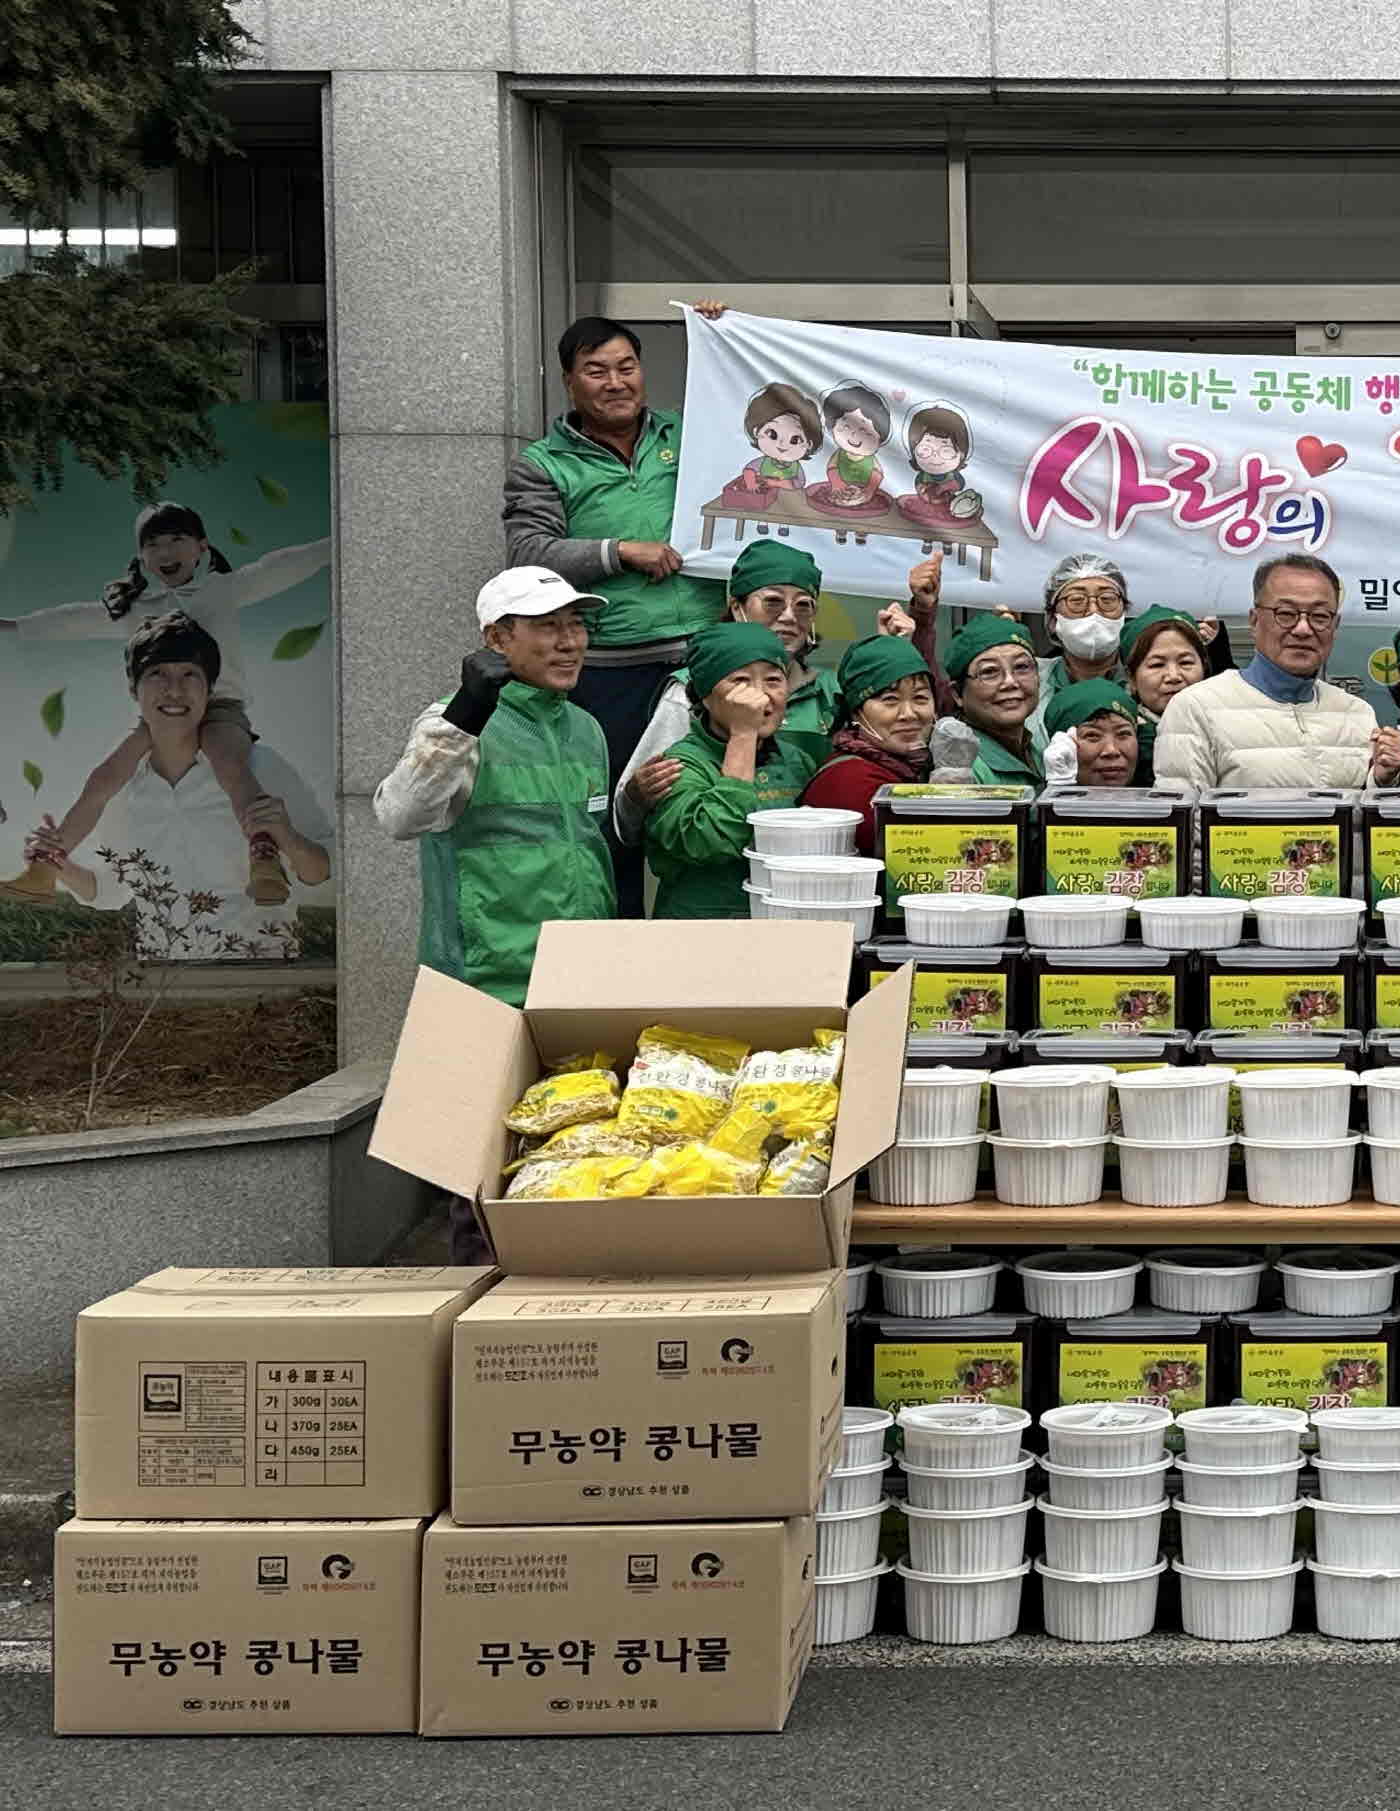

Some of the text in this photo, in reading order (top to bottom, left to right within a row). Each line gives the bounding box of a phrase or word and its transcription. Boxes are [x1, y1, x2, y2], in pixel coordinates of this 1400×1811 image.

[1249, 371, 1351, 412] 공동체
[1024, 420, 1327, 549] 사랑의
[264, 1395, 279, 1408] 가
[291, 1395, 321, 1408] 300g
[264, 1420, 278, 1433] 나
[291, 1420, 321, 1432] 370g
[508, 1422, 762, 1465] 무농약 콩나물
[264, 1444, 280, 1457] 다
[290, 1445, 321, 1457] 450g
[264, 1468, 278, 1481] 라
[109, 1638, 363, 1677] 무농약 콩나물
[477, 1636, 731, 1677] 무농약 콩나물
